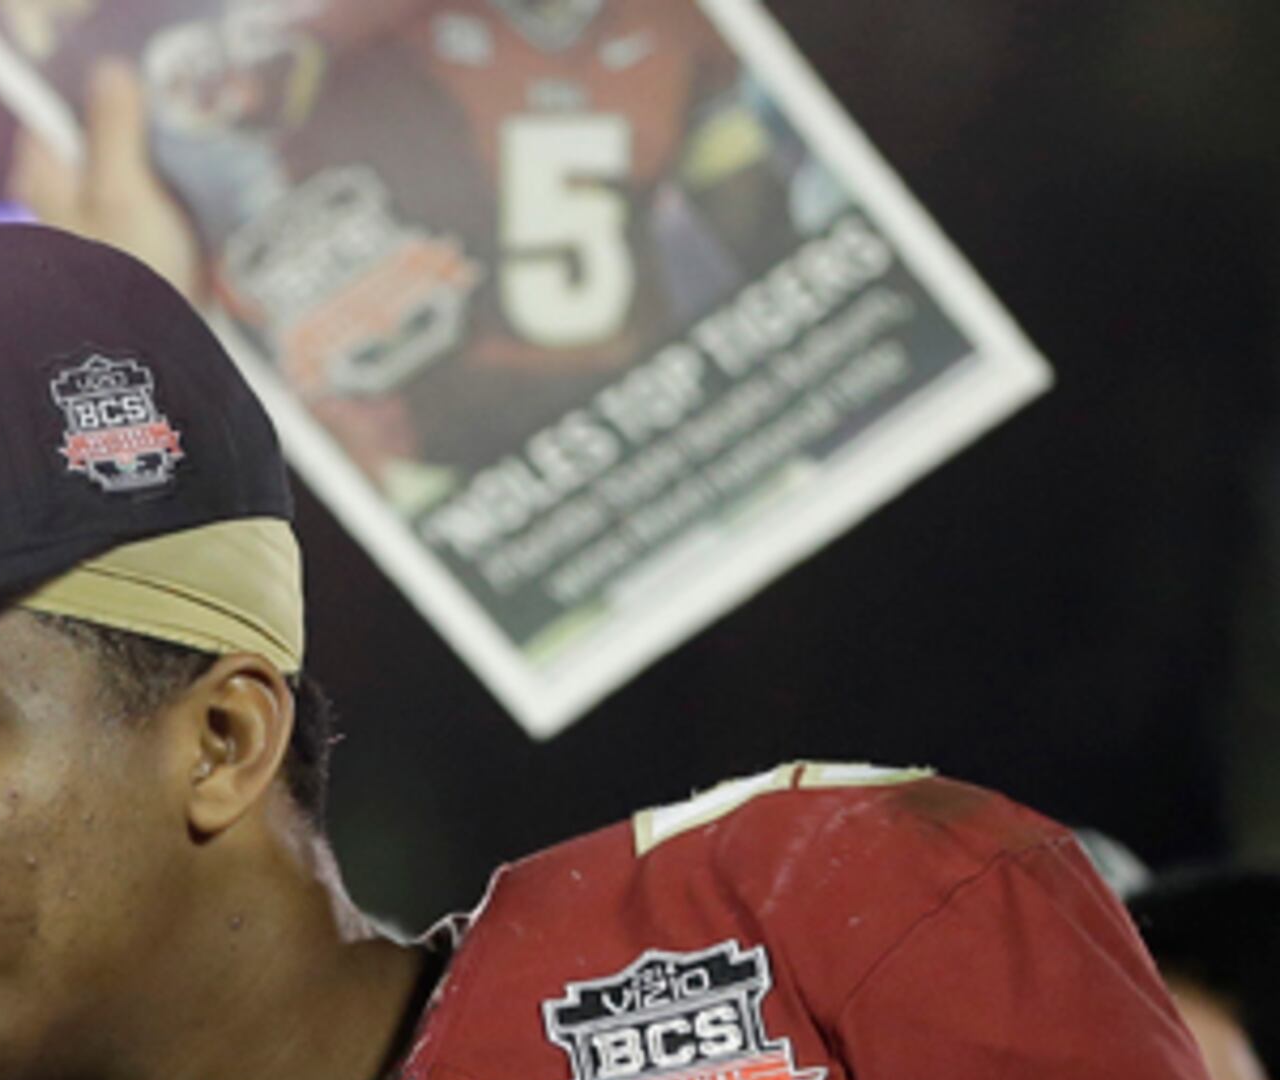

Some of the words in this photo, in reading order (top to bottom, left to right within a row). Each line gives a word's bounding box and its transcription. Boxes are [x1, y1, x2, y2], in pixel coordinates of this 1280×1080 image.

[498, 113, 636, 346] 5
[596, 340, 706, 444] TOP
[690, 212, 894, 378] TIGERS
[74, 396, 147, 429] BCS
